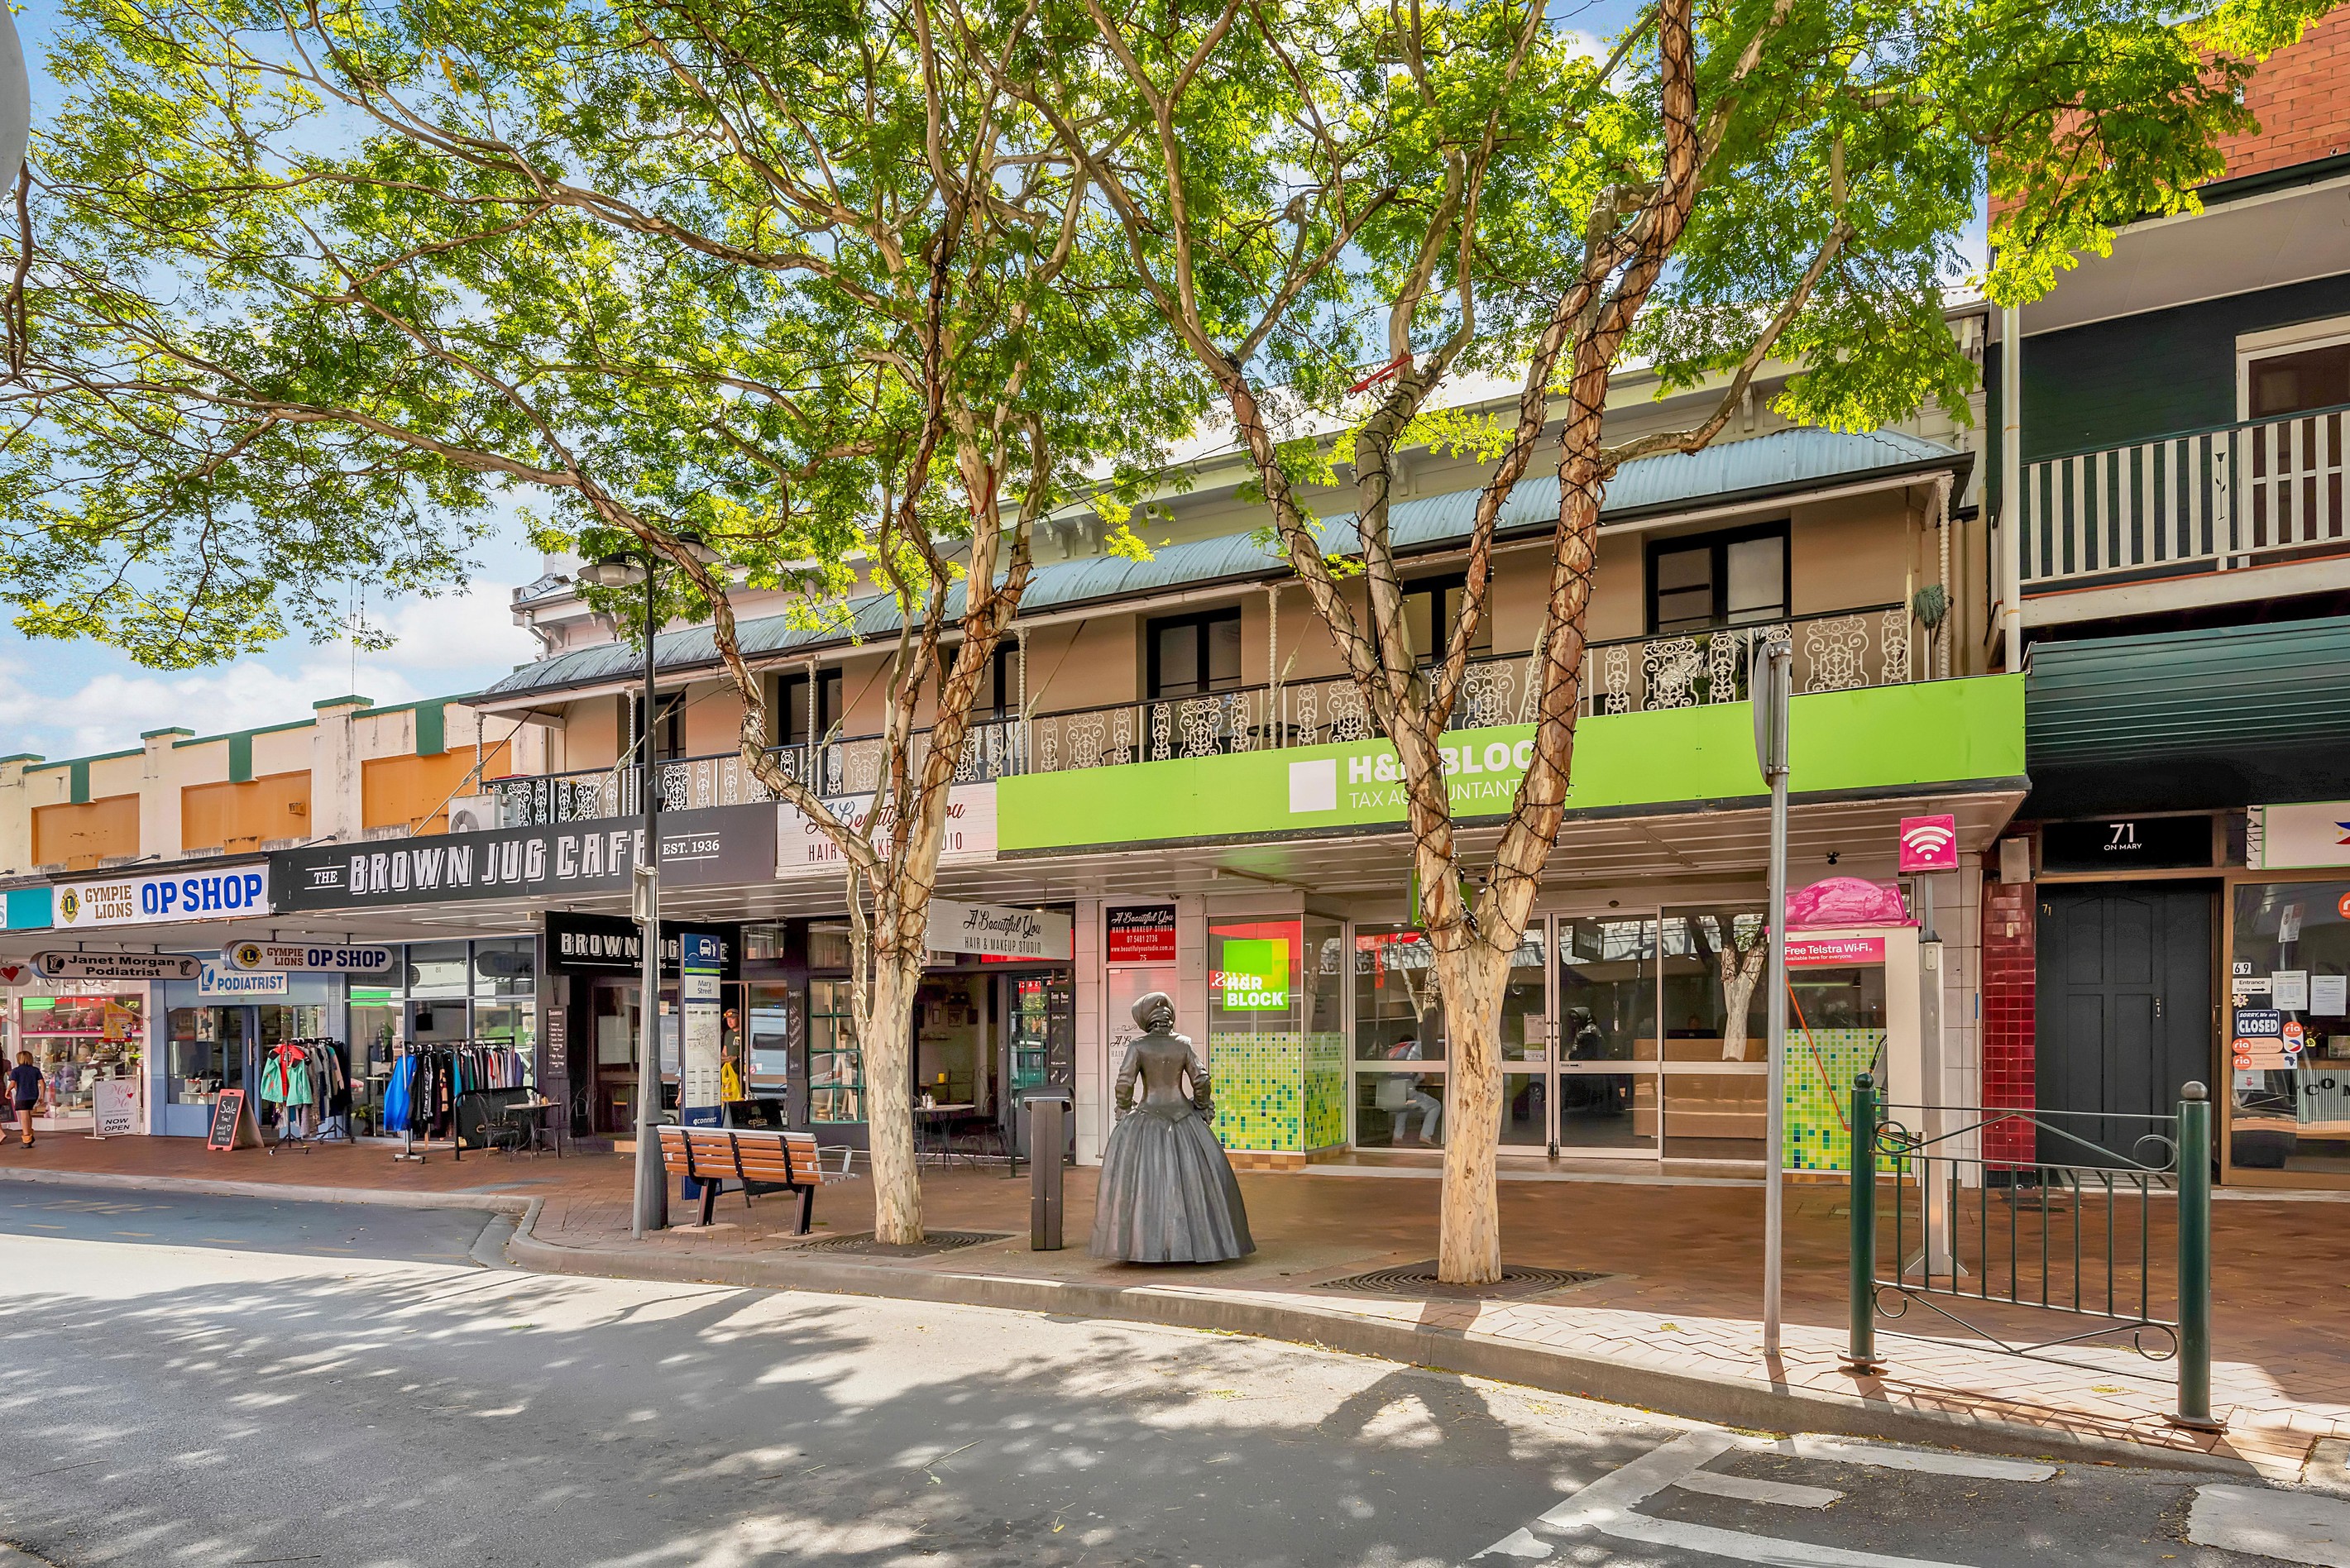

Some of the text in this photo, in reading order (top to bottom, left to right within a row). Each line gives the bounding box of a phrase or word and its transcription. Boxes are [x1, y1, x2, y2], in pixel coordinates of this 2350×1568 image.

[1438, 739, 1536, 776] BLOC
[1349, 791, 1384, 809] TAX
[2110, 823, 2134, 844] 71
[663, 839, 720, 854] EST. 1936
[809, 843, 837, 861] HAIR
[313, 870, 338, 884] THE
[349, 844, 474, 896] BROWN
[481, 838, 547, 886] JUG
[85, 873, 262, 915] GYMPIE OP SHOP
[95, 902, 133, 920] LIONS
[2042, 903, 2051, 915] 71
[979, 911, 1022, 935] Beautiful
[1022, 915, 1042, 939] You
[1123, 911, 1158, 925] Beautiful
[1157, 911, 1175, 925] You
[561, 933, 640, 958] BROWN
[964, 936, 1041, 954] HAIR & MAKEUP STUDIO
[1127, 935, 1132, 944] 07
[1784, 945, 1807, 955] Free
[1807, 944, 1843, 954] Telstra
[68, 955, 175, 968] Janet Morgan
[267, 948, 386, 968] GYMPIE OP SHOP
[275, 958, 304, 967] LIONS
[86, 967, 161, 977] Podiatrist
[218, 976, 284, 990] PODIATRIST
[698, 980, 712, 988] Mary
[1228, 976, 1262, 991] H&R
[1228, 992, 1284, 1006] BLOCK
[2238, 1020, 2278, 1033] CLOSED
[2285, 1024, 2300, 1032] ria
[2234, 1040, 2249, 1049] ria
[2235, 1056, 2250, 1064] ria
[220, 1101, 237, 1114] Sale
